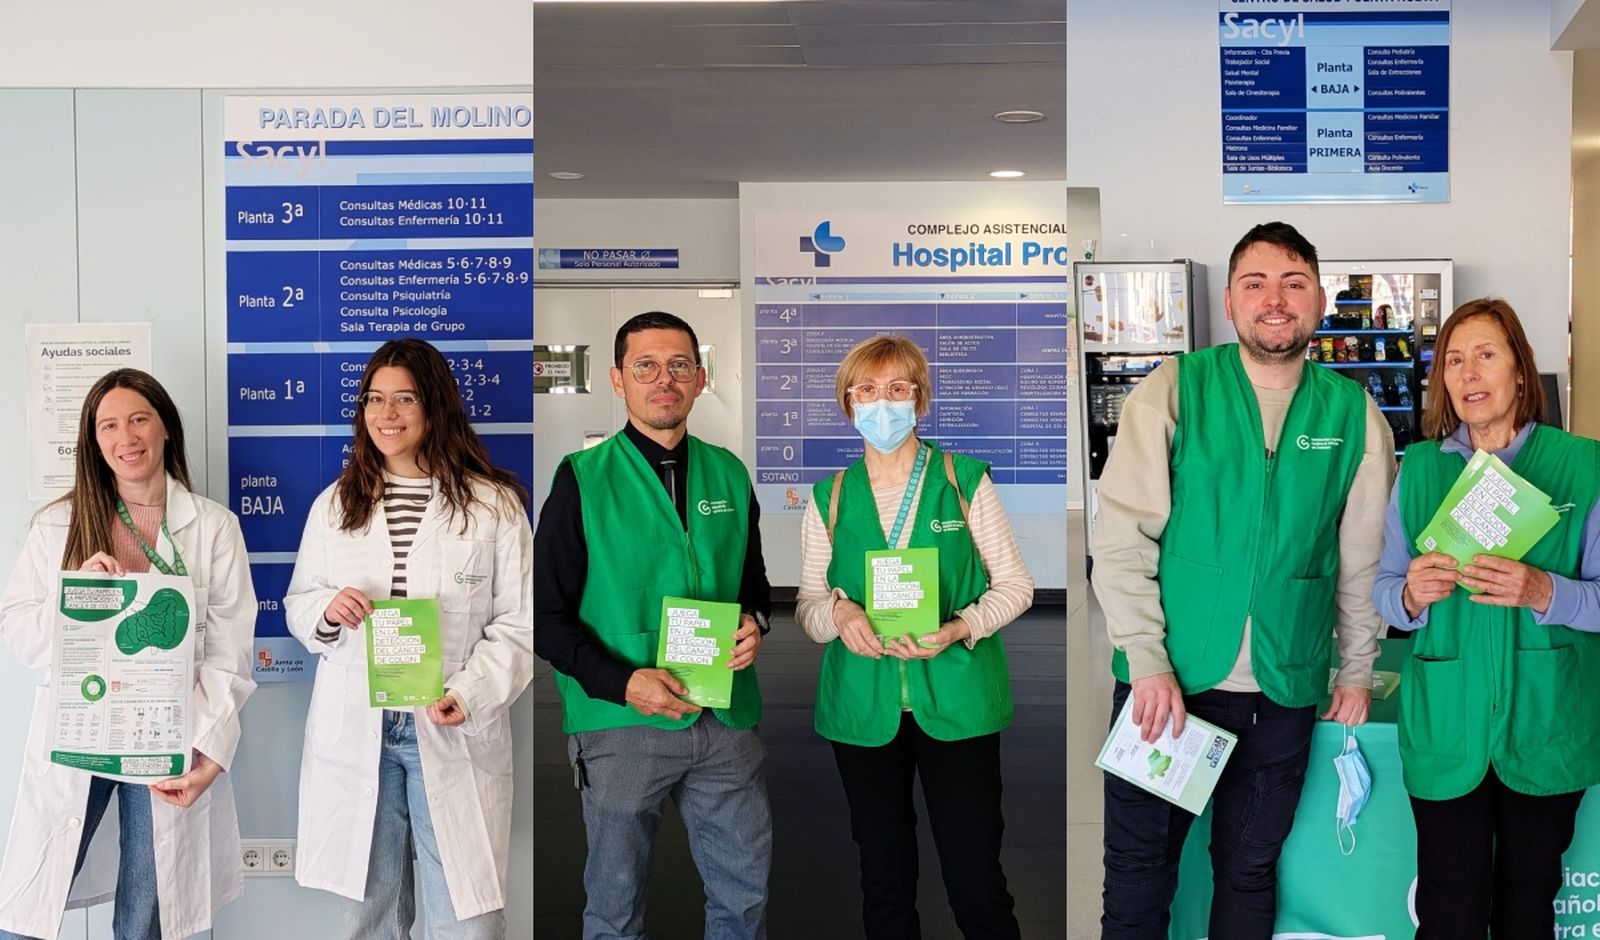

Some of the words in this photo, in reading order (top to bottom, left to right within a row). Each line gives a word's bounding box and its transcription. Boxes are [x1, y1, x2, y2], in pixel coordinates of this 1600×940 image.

[1224, 13, 1304, 46] Sacyl
[1317, 63, 1353, 72] Planta
[1321, 84, 1349, 94] BAJA
[259, 107, 364, 129] PARADA
[373, 106, 423, 128] DEL
[431, 105, 532, 127] MOLINO
[1317, 129, 1353, 138] Planta
[235, 140, 326, 177] Sacyl
[1309, 148, 1362, 157] PRIMERA
[340, 200, 395, 211] Consultas
[398, 199, 443, 210] Médicas
[238, 211, 274, 224] Planta
[340, 216, 395, 227] Consultas
[398, 214, 460, 226] Enfermería
[907, 224, 979, 235] COMPLEJO
[983, 223, 1067, 234] ASISTENCIAL
[583, 250, 599, 259] NO
[603, 250, 636, 259] PASAR
[893, 242, 1011, 272] Hospital
[340, 260, 395, 271] Consultas
[398, 259, 443, 270] Médicas
[340, 276, 395, 286] Consultas
[398, 274, 460, 286] Enfermería
[239, 295, 275, 308] Planta
[340, 291, 389, 301] Consulta
[393, 290, 451, 302] Psiquiatría
[340, 307, 389, 317] Consulta
[393, 306, 448, 318] Psicología
[340, 322, 365, 332] Sala
[368, 322, 410, 334] Terapia
[413, 321, 428, 332] de
[431, 321, 466, 333] Grupo
[41, 348, 83, 359] Ayudas
[86, 346, 132, 356] sociales
[240, 387, 276, 400] Planta
[783, 446, 794, 461] 0
[241, 475, 277, 490] planta
[762, 472, 799, 482] SOTANO
[241, 496, 285, 515] BAJA
[256, 665, 280, 673] Castilla
[274, 659, 293, 667] Junta
